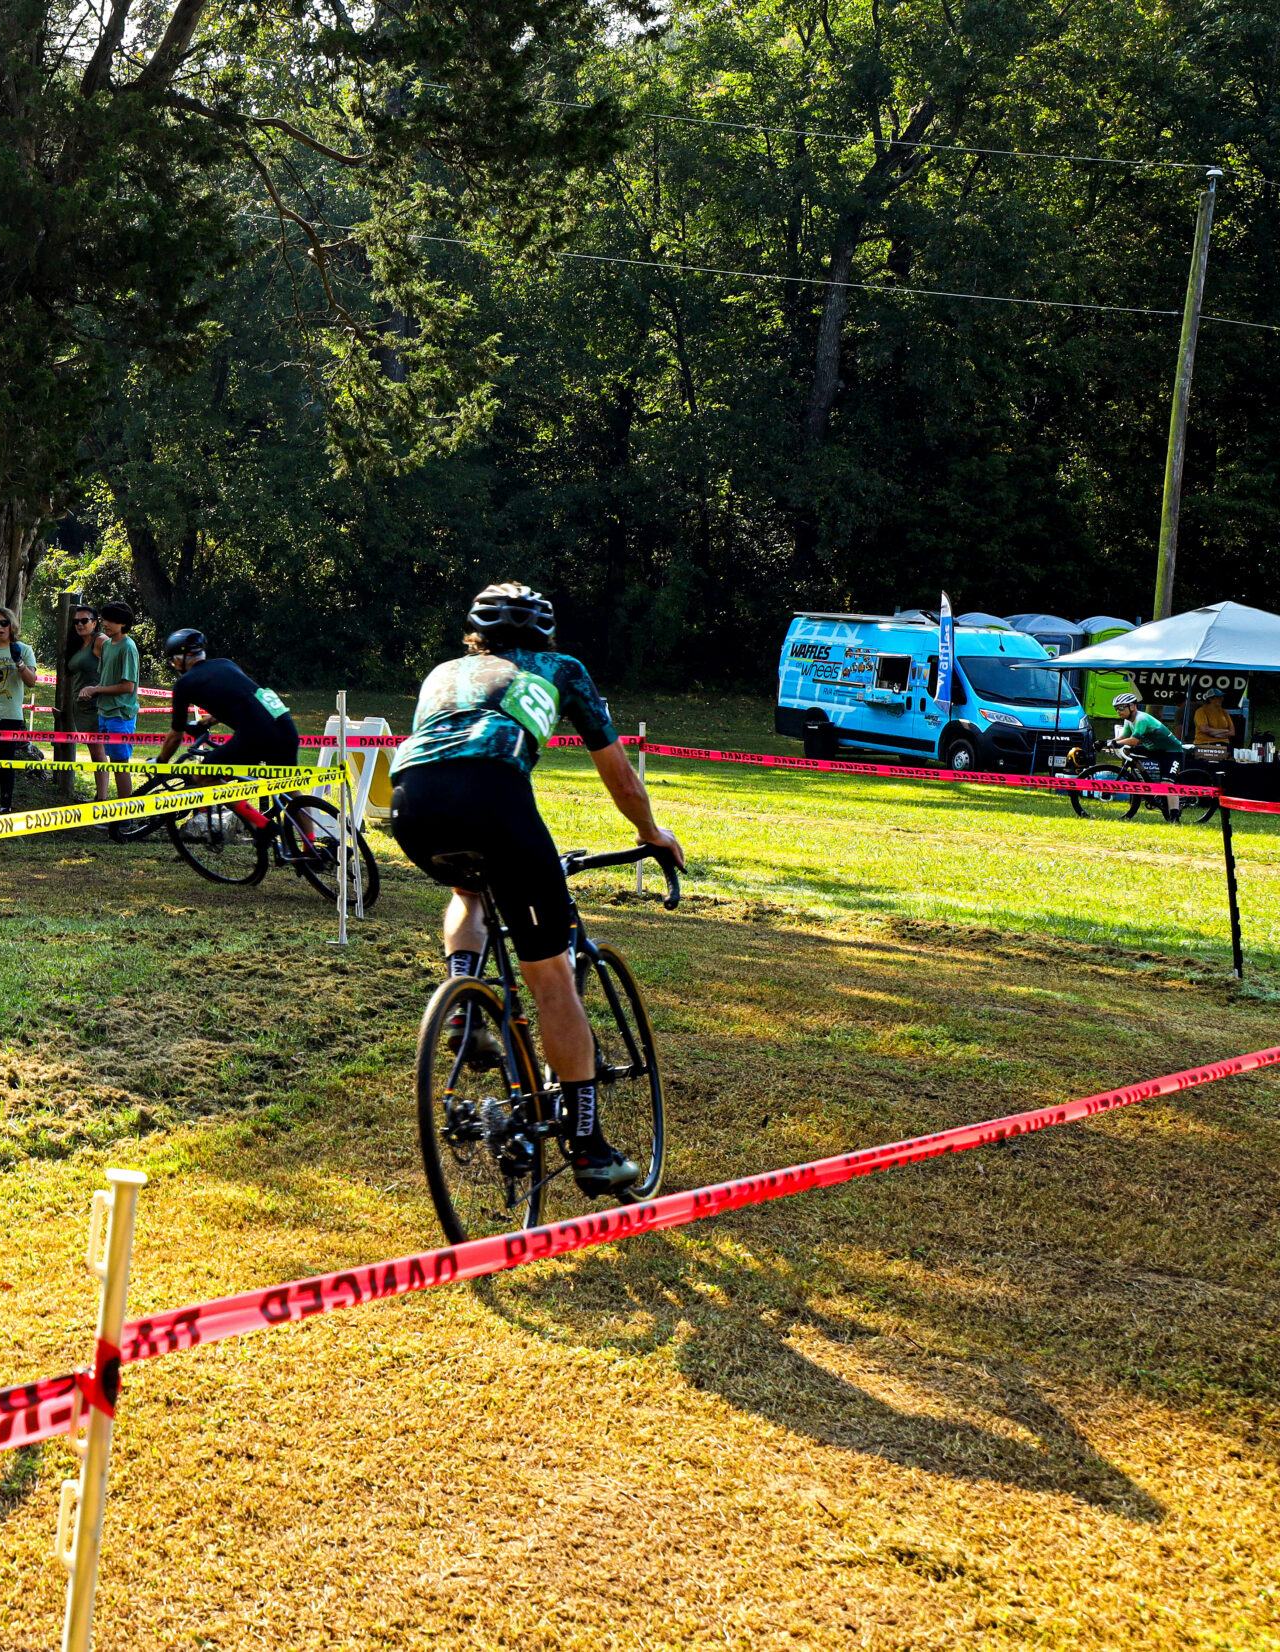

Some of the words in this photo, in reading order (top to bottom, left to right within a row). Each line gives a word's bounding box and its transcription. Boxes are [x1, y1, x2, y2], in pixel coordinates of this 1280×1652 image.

[790, 643, 832, 660] WAFFLES
[801, 659, 840, 679] wheels
[12, 732, 56, 742] DANGER
[66, 733, 111, 743] DANGER
[25, 808, 82, 829] CAUTION
[92, 801, 145, 820] CAUTION
[155, 792, 204, 810] CAUTION
[213, 784, 259, 801] CAUTION
[267, 776, 311, 791] CAUTION
